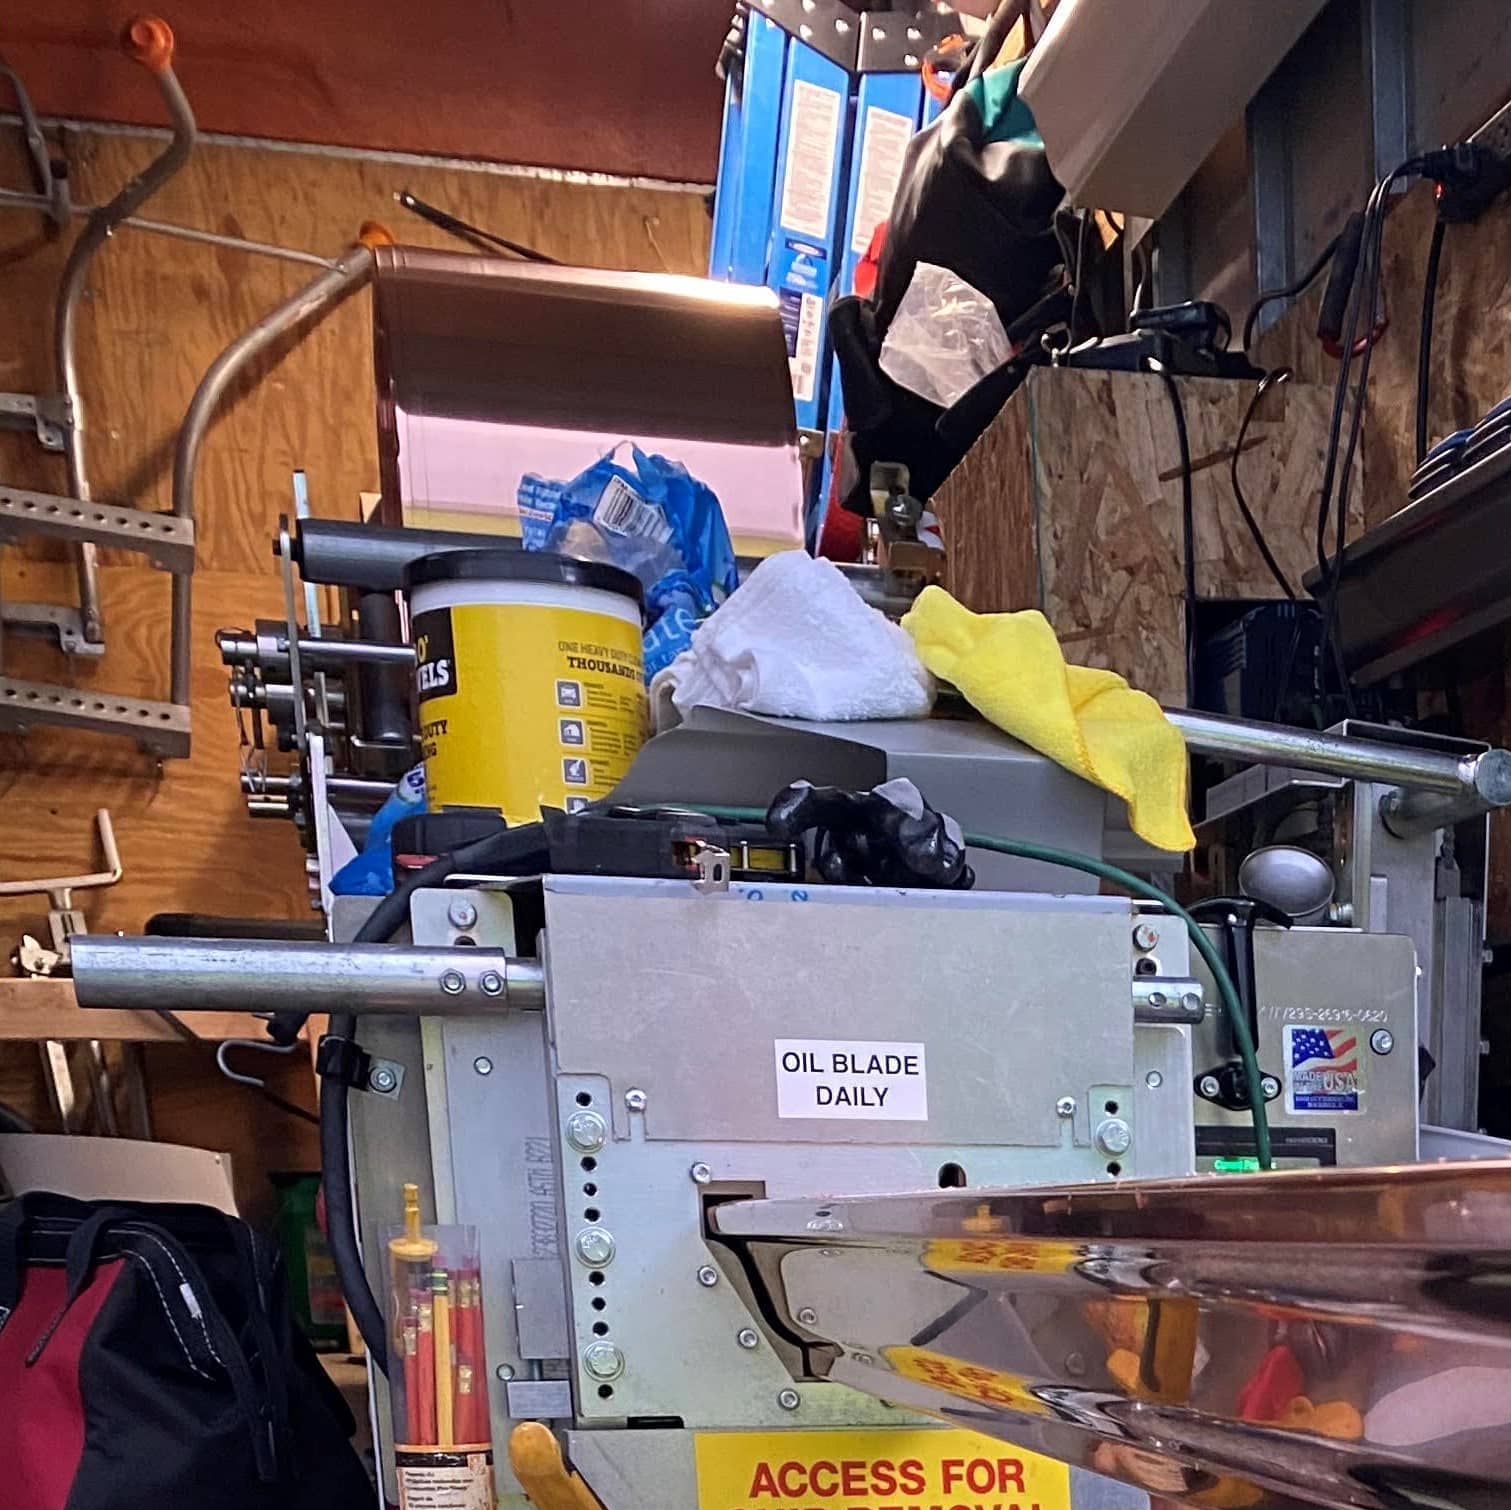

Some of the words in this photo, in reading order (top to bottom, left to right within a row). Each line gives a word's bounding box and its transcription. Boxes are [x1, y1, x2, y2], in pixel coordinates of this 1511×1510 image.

[782, 1052, 824, 1073] OIL
[832, 1053, 919, 1076] BLADE
[1323, 1070, 1356, 1091] USA
[816, 1085, 889, 1107] DAILY
[749, 1460, 927, 1498] ACCESS
[942, 1458, 1026, 1495] FOR
